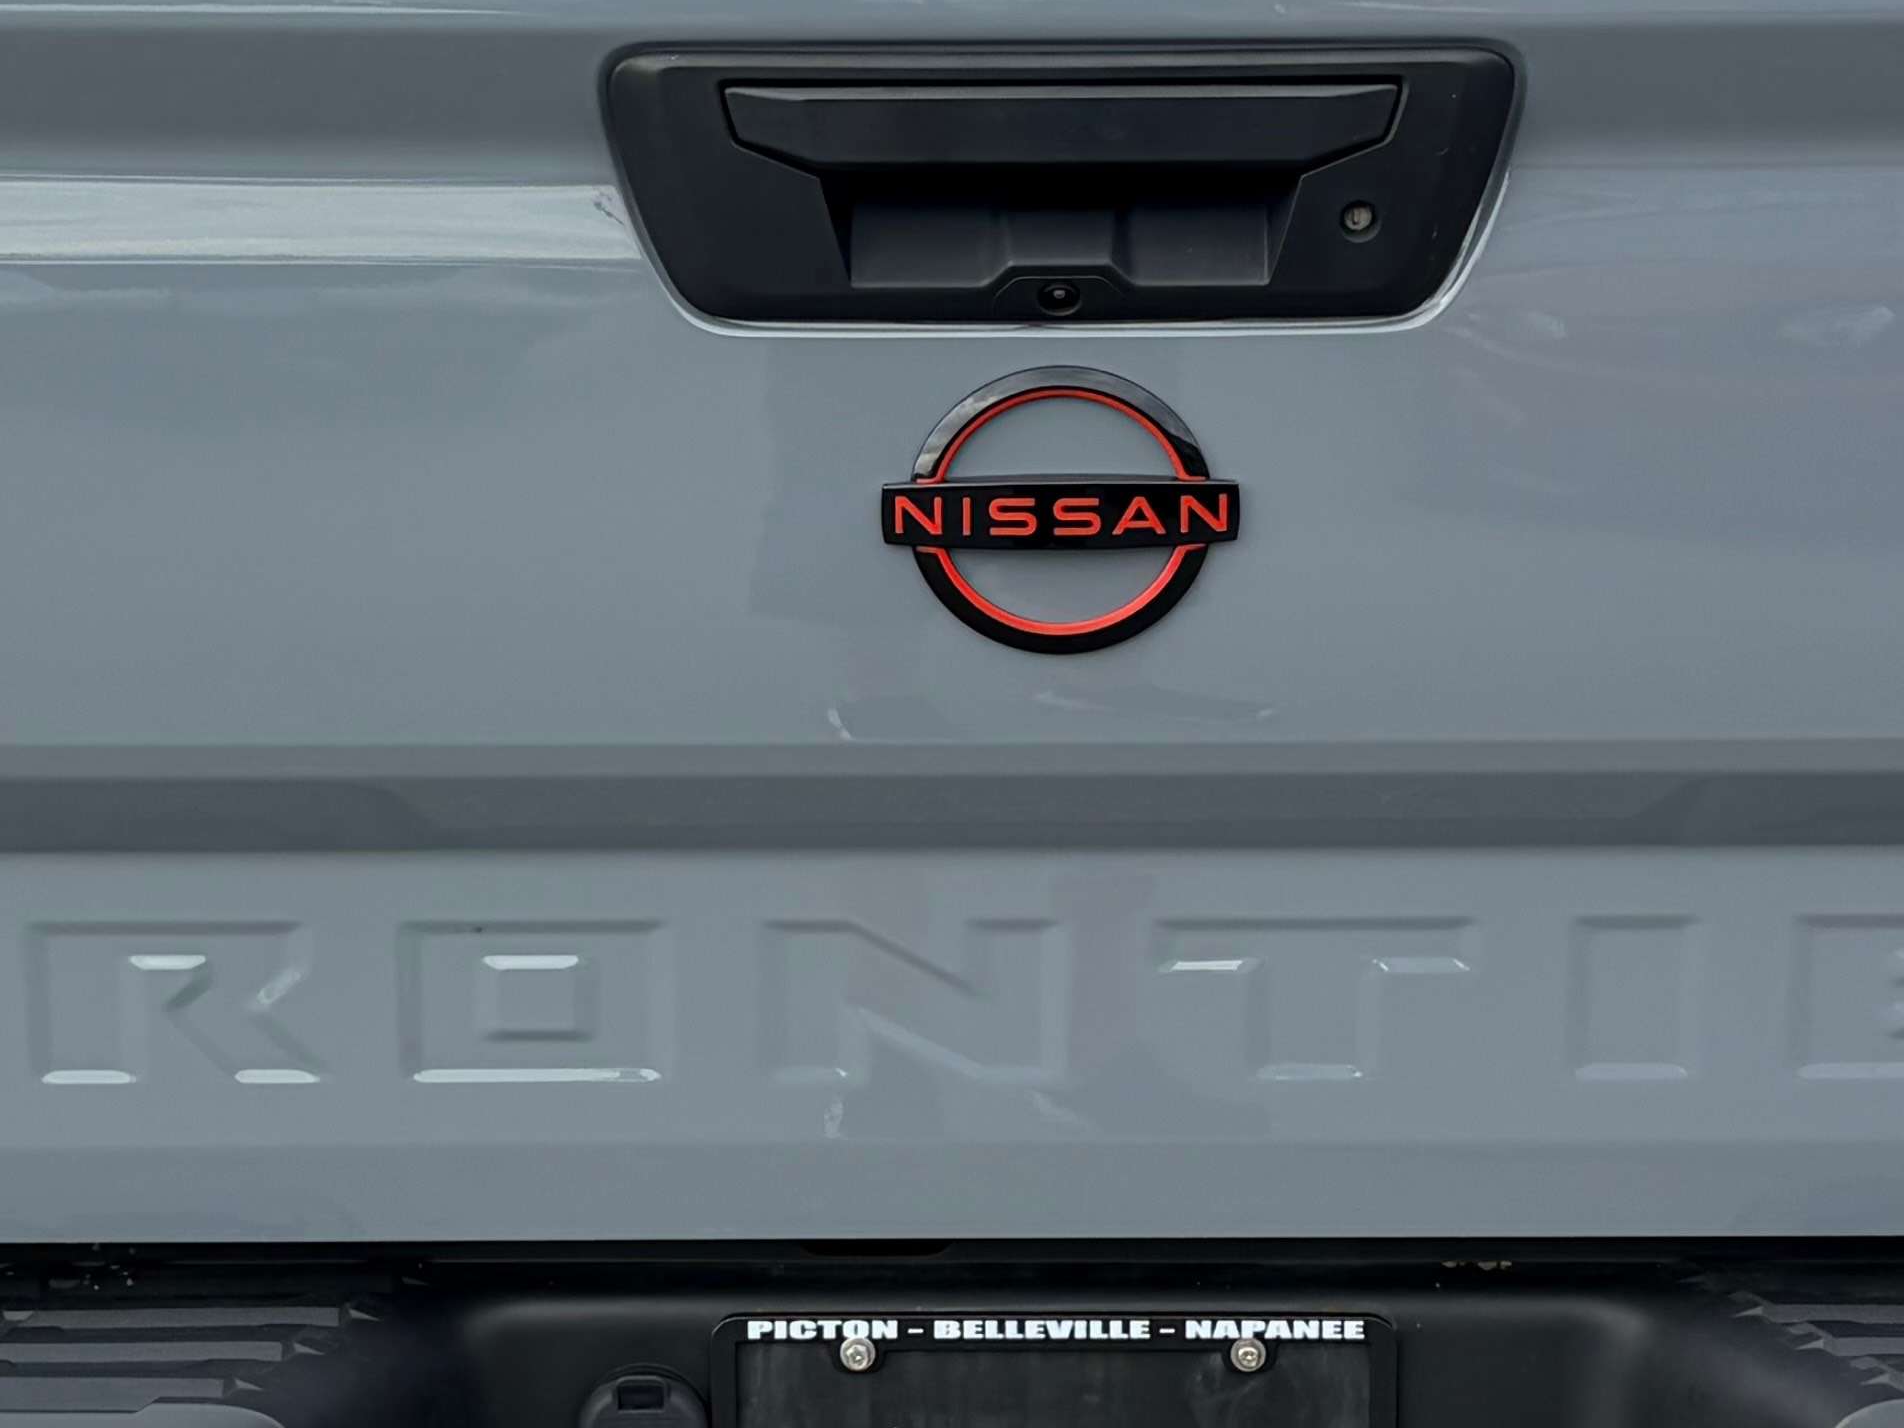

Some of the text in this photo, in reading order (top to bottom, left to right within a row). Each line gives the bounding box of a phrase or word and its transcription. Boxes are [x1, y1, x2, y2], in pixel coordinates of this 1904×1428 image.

[895, 493, 1228, 537] NISSAN
[747, 1320, 898, 1340] PICTON
[934, 1320, 1150, 1340] BELLEVILLE
[1185, 1320, 1365, 1340] NAPANEE
